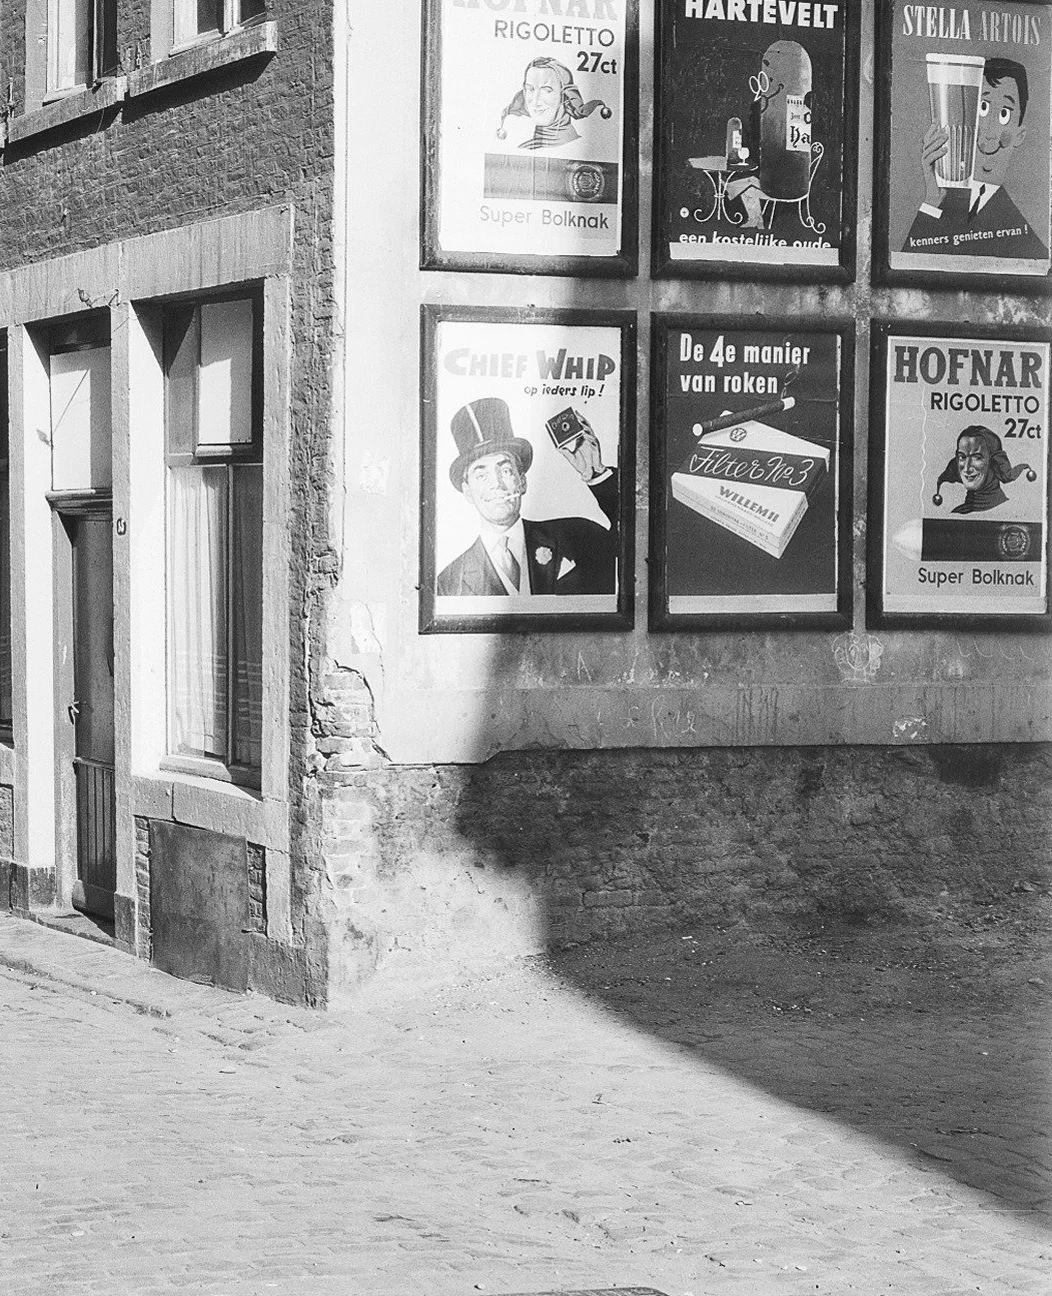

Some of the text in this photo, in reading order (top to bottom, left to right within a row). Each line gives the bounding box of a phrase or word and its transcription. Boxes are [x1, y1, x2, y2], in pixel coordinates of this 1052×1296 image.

[494, 19, 615, 47] RIGOLETTO
[903, 4, 1042, 46] STELLA ARTOIS
[576, 50, 618, 75] 27ct
[480, 205, 609, 229] Super Bolknak
[679, 230, 832, 249] een kostelijke oude
[909, 235, 950, 247] kenners
[953, 230, 994, 246] genieten
[680, 333, 811, 368] De 4e manier
[443, 347, 616, 381] CHIEF WHIP
[894, 345, 1043, 388] HOFNAR
[523, 386, 538, 397] op
[542, 383, 577, 397] ieders
[680, 371, 778, 394] van roken
[930, 392, 1040, 414] RIGOLETTO
[1004, 417, 1042, 439] 27ct
[689, 446, 765, 480] Filter
[720, 485, 769, 517] WILLEM
[918, 567, 1034, 588] Super Bolknak
